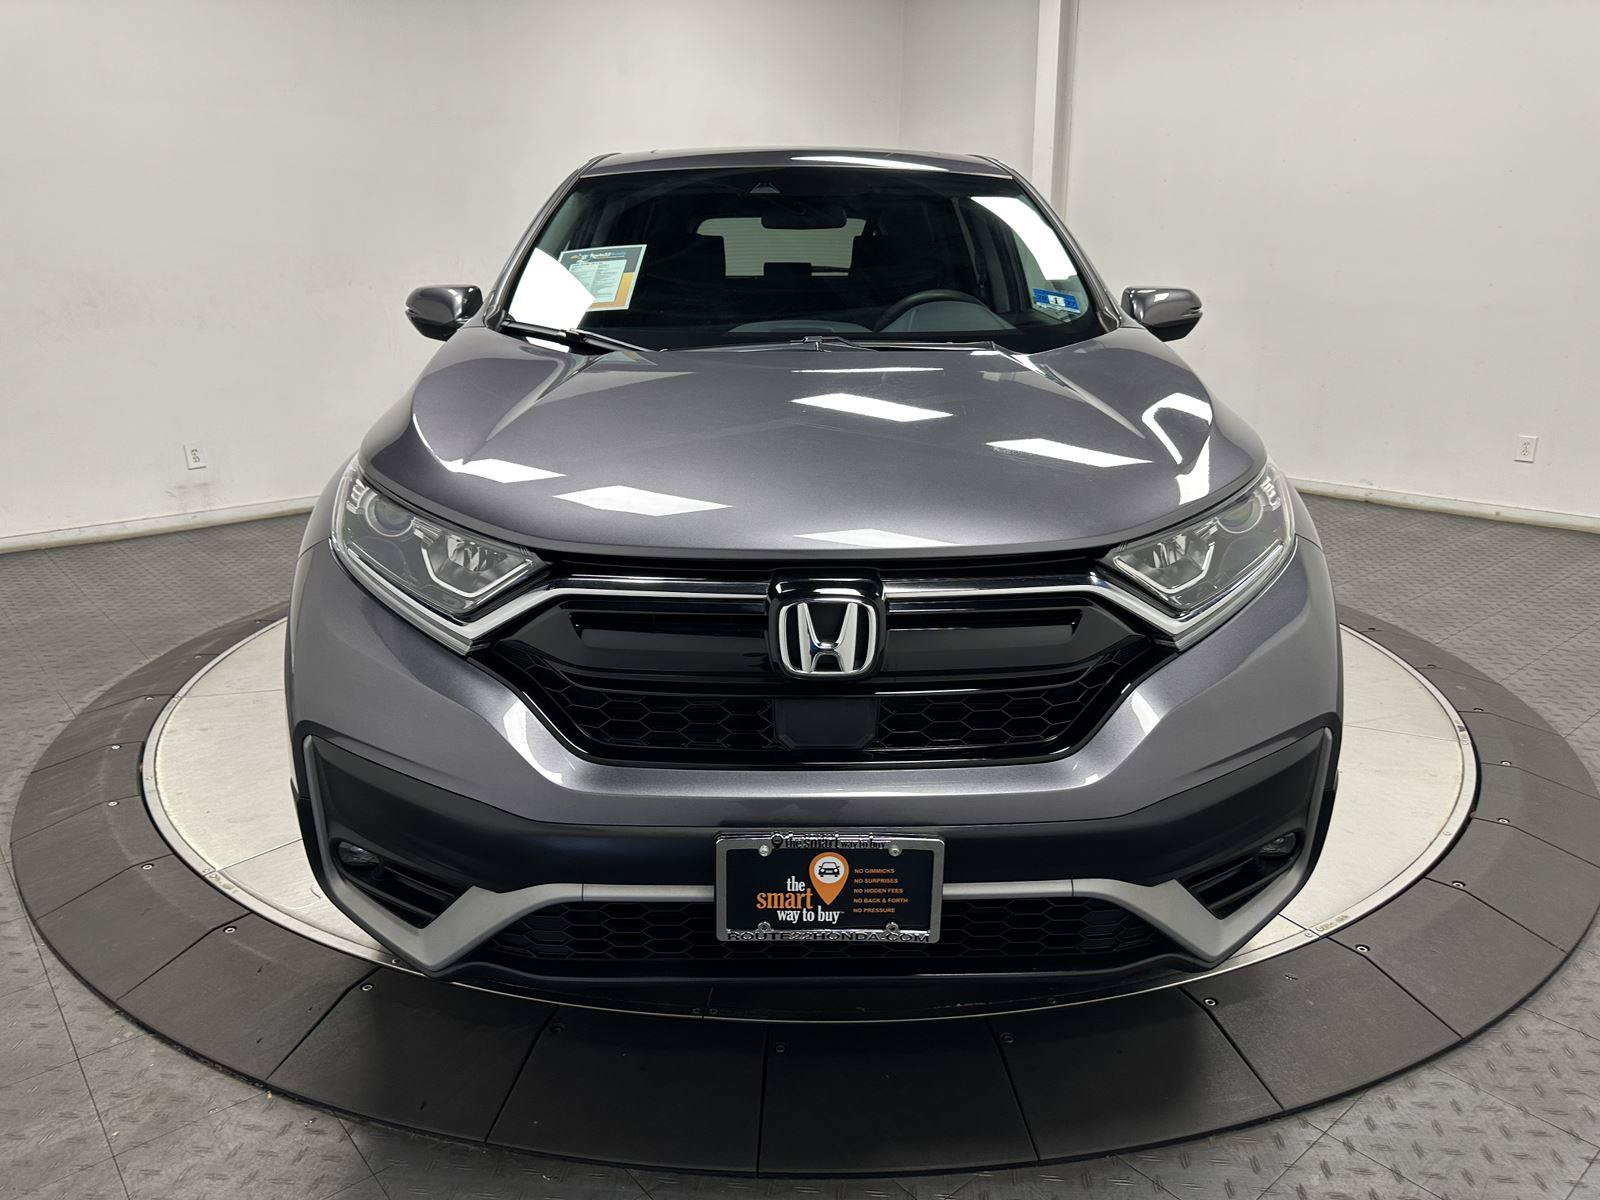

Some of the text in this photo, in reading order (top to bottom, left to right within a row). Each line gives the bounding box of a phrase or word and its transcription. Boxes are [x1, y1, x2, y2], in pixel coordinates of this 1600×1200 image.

[786, 875, 806, 891] the
[756, 887, 813, 909] smart
[776, 905, 840, 924] way to buy
